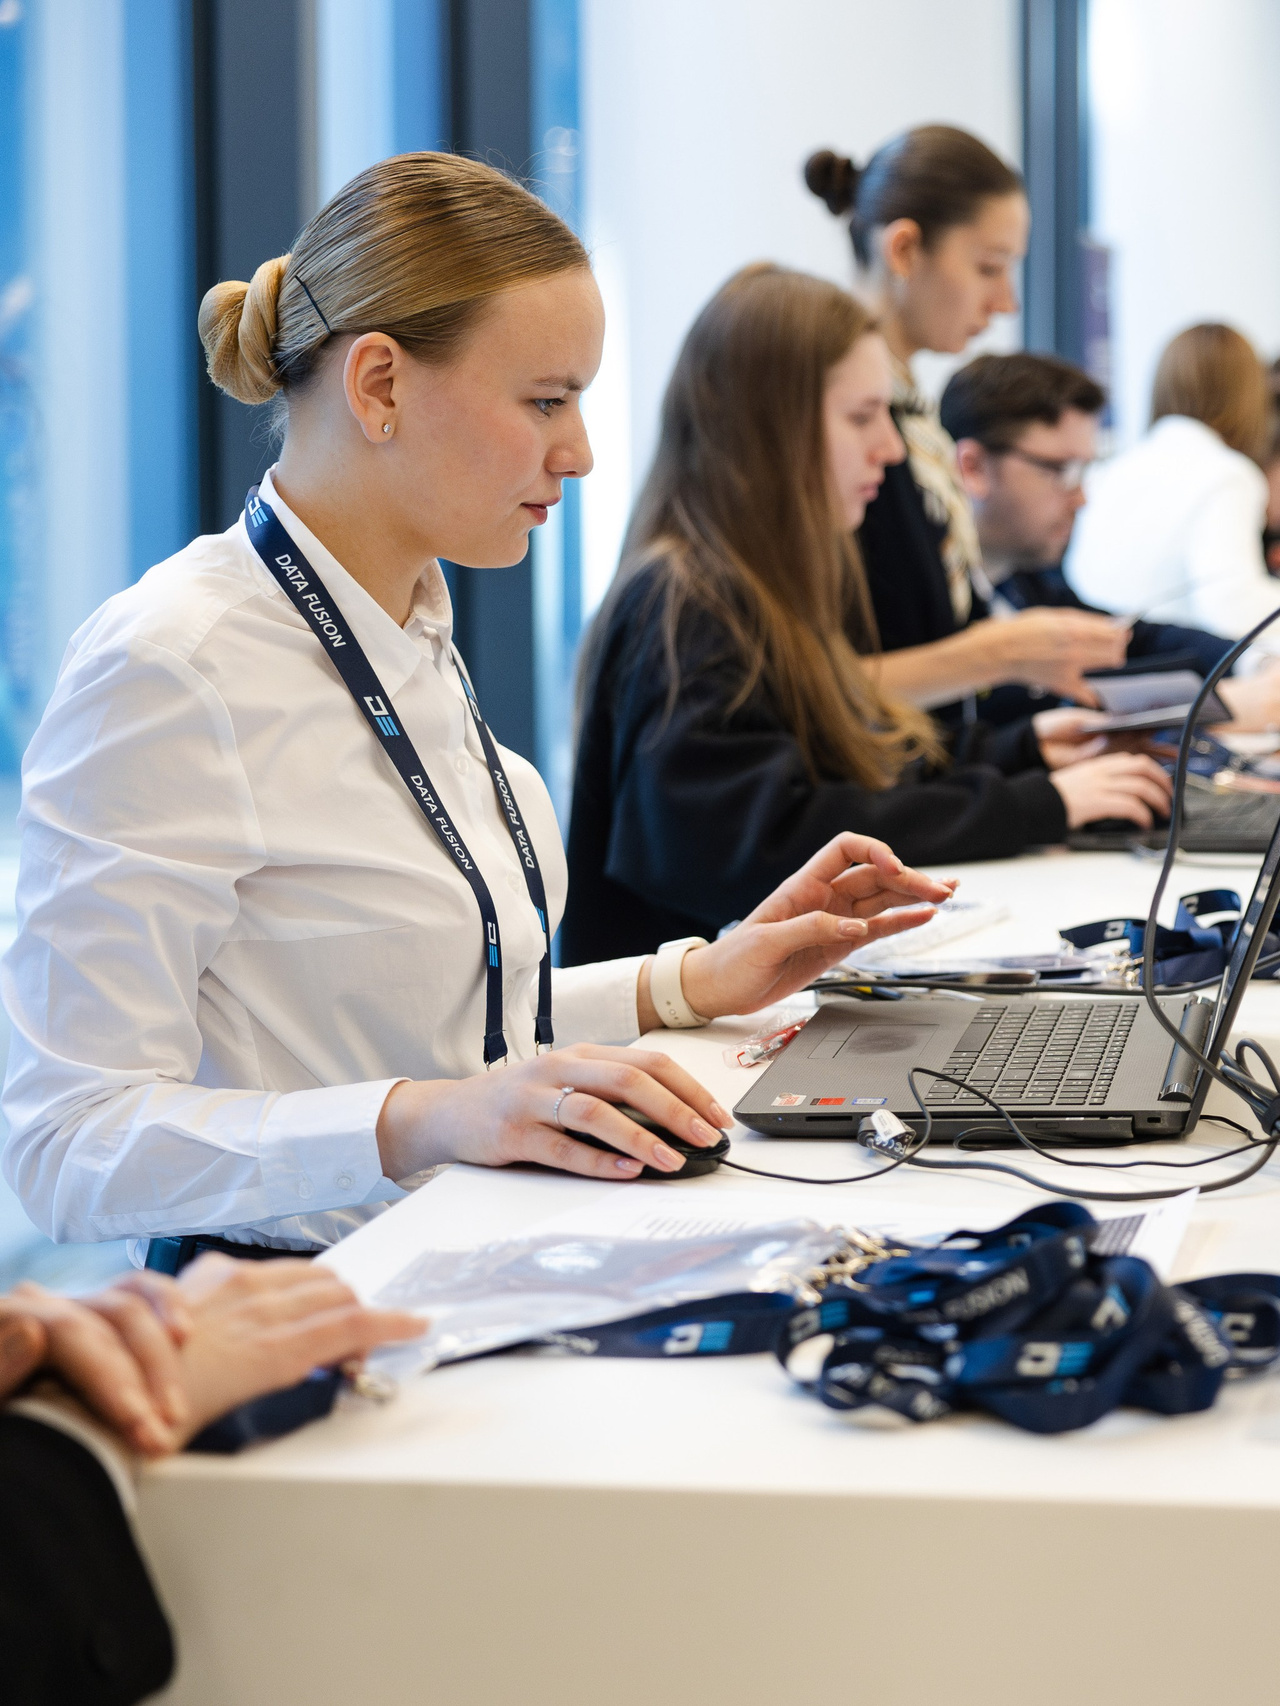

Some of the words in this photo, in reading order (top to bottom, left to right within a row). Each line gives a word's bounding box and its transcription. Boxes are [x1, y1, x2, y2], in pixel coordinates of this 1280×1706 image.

[275, 554, 309, 593] DATA
[302, 593, 347, 648] FUSION
[410, 774, 438, 814] DATA
[435, 816, 473, 871] FUSION
[494, 770, 520, 826] FUSION
[515, 829, 535, 869] DATA
